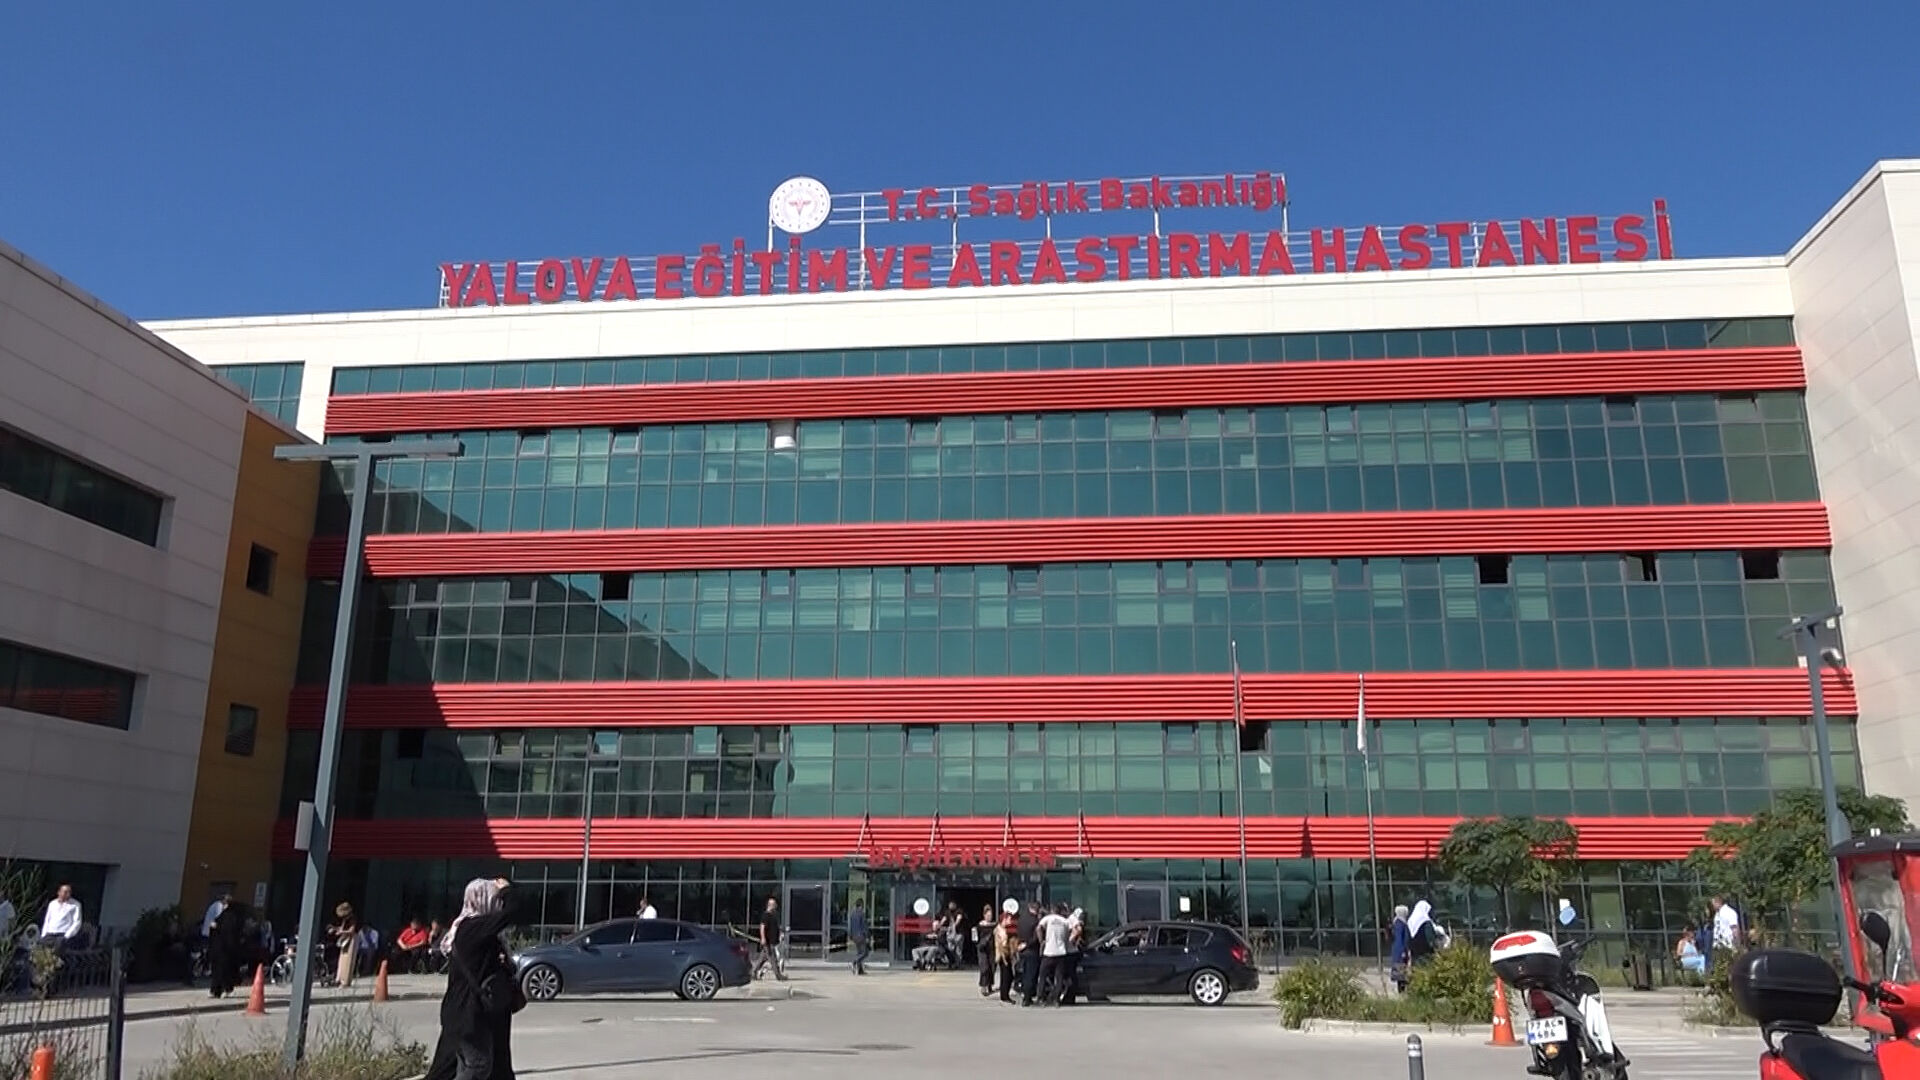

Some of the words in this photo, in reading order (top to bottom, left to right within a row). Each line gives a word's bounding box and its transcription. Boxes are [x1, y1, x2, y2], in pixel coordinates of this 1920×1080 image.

[882, 188, 957, 221] T.C.
[968, 181, 1089, 220] Sağlık
[1099, 172, 1287, 210] Bakanlığı
[440, 256, 637, 308] YALOVA
[655, 236, 847, 300] EĞİTİM
[862, 245, 932, 291] VE
[1310, 198, 1674, 274] HASTANESİ
